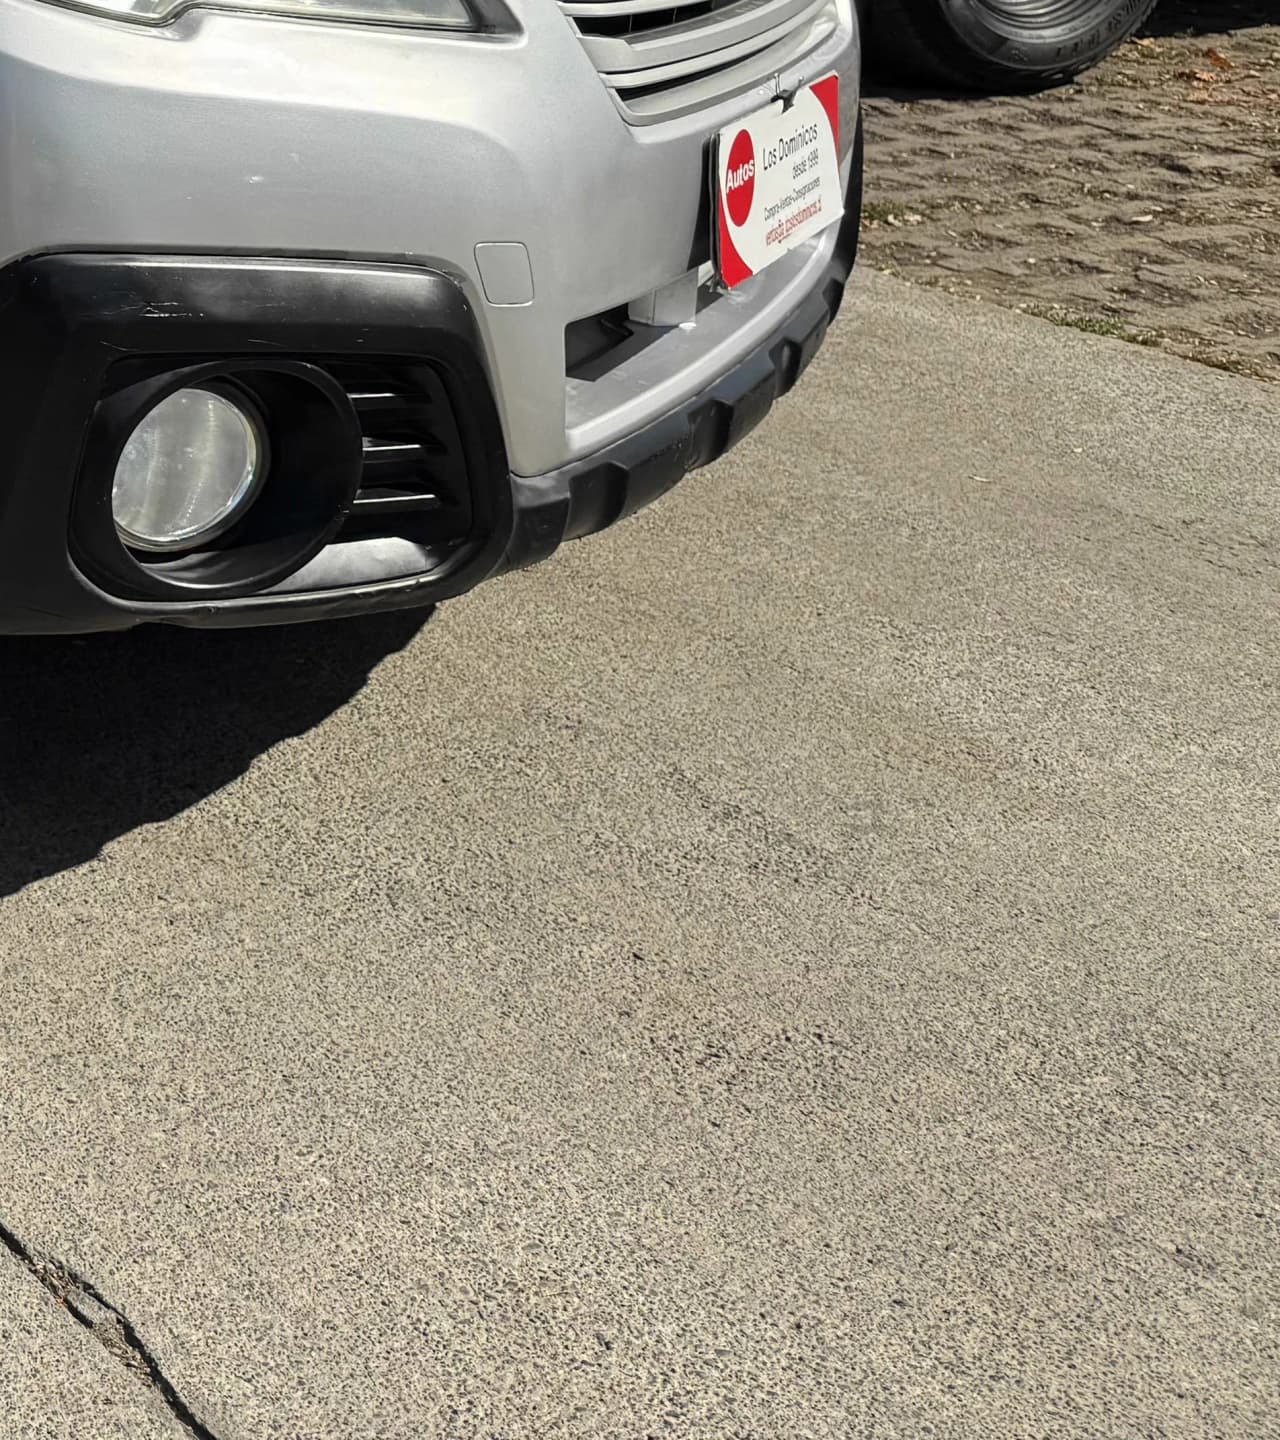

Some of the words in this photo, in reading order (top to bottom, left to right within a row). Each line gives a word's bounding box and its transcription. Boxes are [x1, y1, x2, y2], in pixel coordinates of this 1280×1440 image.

[726, 159, 755, 194] Autos
[762, 147, 777, 171] Los
[778, 123, 818, 162] Dominicos
